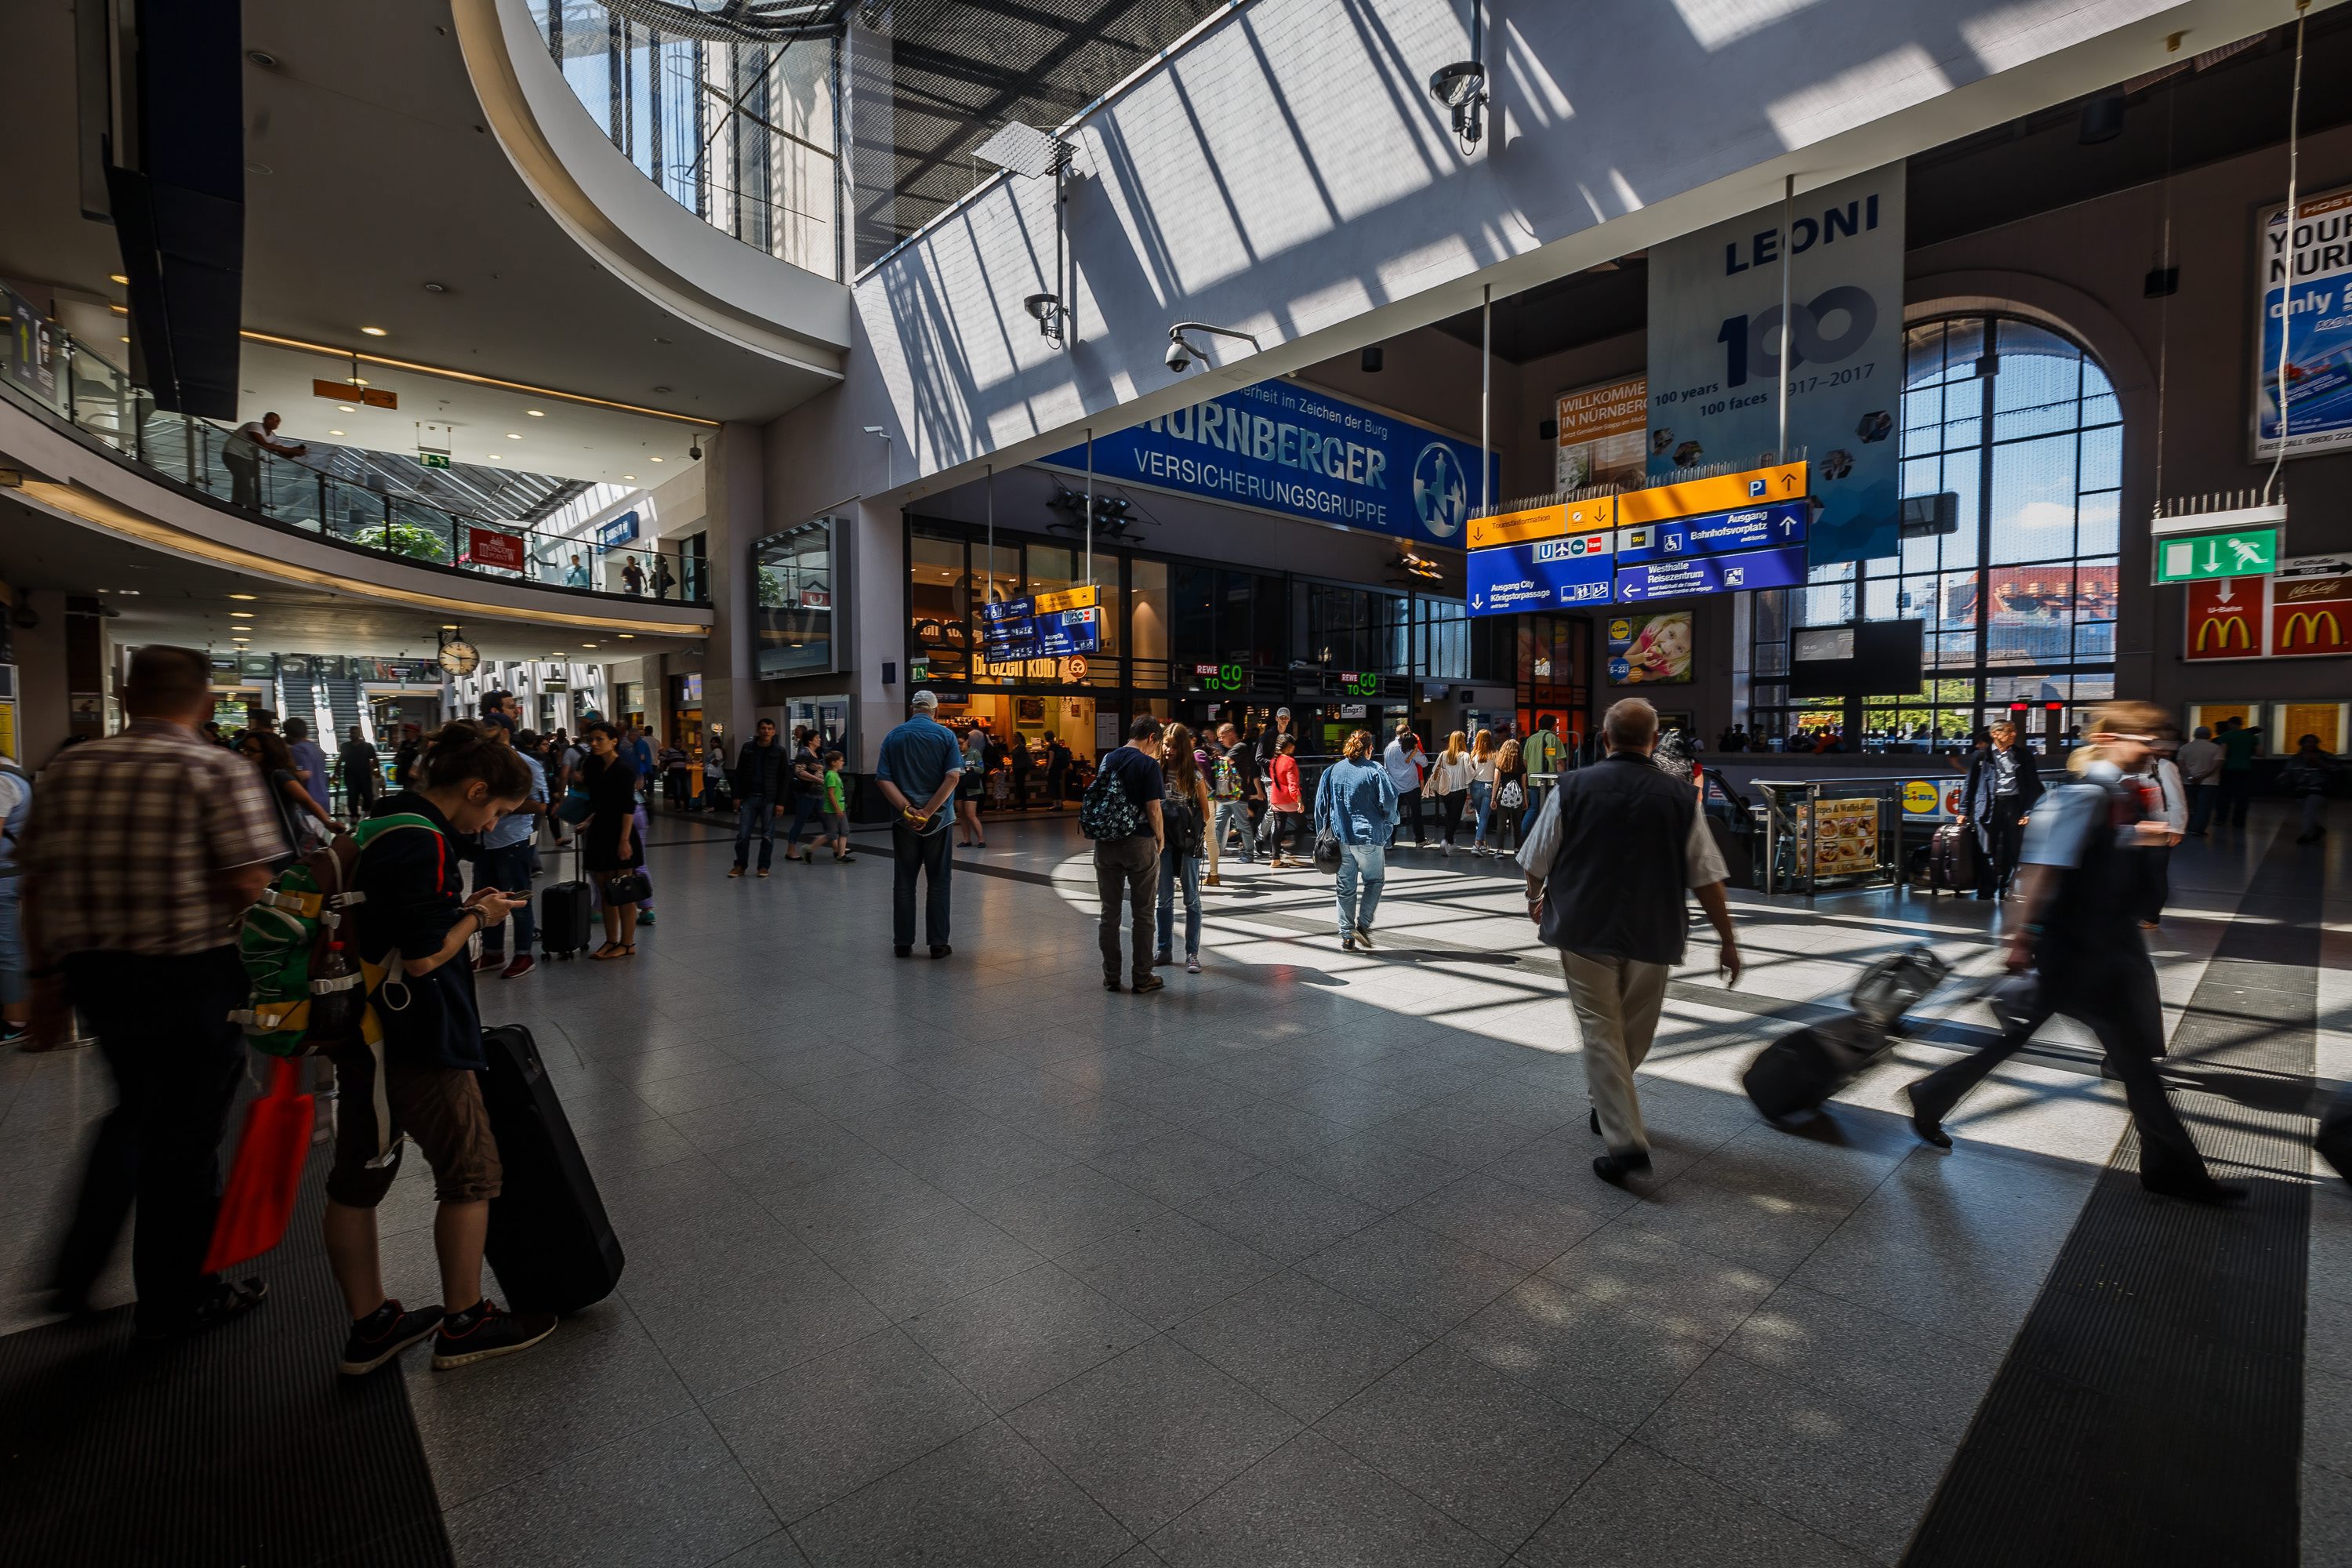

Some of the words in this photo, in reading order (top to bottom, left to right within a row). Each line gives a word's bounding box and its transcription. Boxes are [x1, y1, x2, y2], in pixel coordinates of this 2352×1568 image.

[1726, 194, 1878, 276] LEONI
[2270, 241, 2352, 283] NUR
[1718, 285, 1878, 389] 100
[1778, 363, 1875, 397] 917–2017
[1562, 381, 1646, 413] WILLKOMME
[1654, 393, 1677, 406] 100
[1681, 383, 1719, 404] years
[1700, 402, 1725, 417] 100
[1729, 392, 1768, 412] faces
[1282, 393, 1295, 408] im
[1299, 397, 1341, 423] Zeichen
[1345, 414, 1362, 430] der
[1365, 419, 1388, 441] Burg
[1562, 415, 1576, 429] IN
[1134, 448, 1387, 525] VERSICHERUNGSGRUPPE
[1750, 481, 1762, 496] P
[1492, 514, 1551, 529] Touristinformation
[1727, 511, 1768, 524] Ausgang
[1690, 522, 1768, 540] Bahnhofsvorplatz
[1541, 545, 1552, 558] U
[1648, 562, 1690, 574] Westhalle
[1647, 571, 1704, 583] Reisezentrum
[1491, 583, 1519, 592] Ausgang
[1520, 580, 1534, 590] City
[1490, 590, 1551, 603] Königstorpassage
[1197, 666, 1218, 674] REWE
[1221, 665, 1243, 681] GO
[1204, 678, 1219, 690] TO
[1360, 673, 1376, 688] GO
[1347, 685, 1359, 695] TO
[1903, 791, 1936, 801] LIDL
